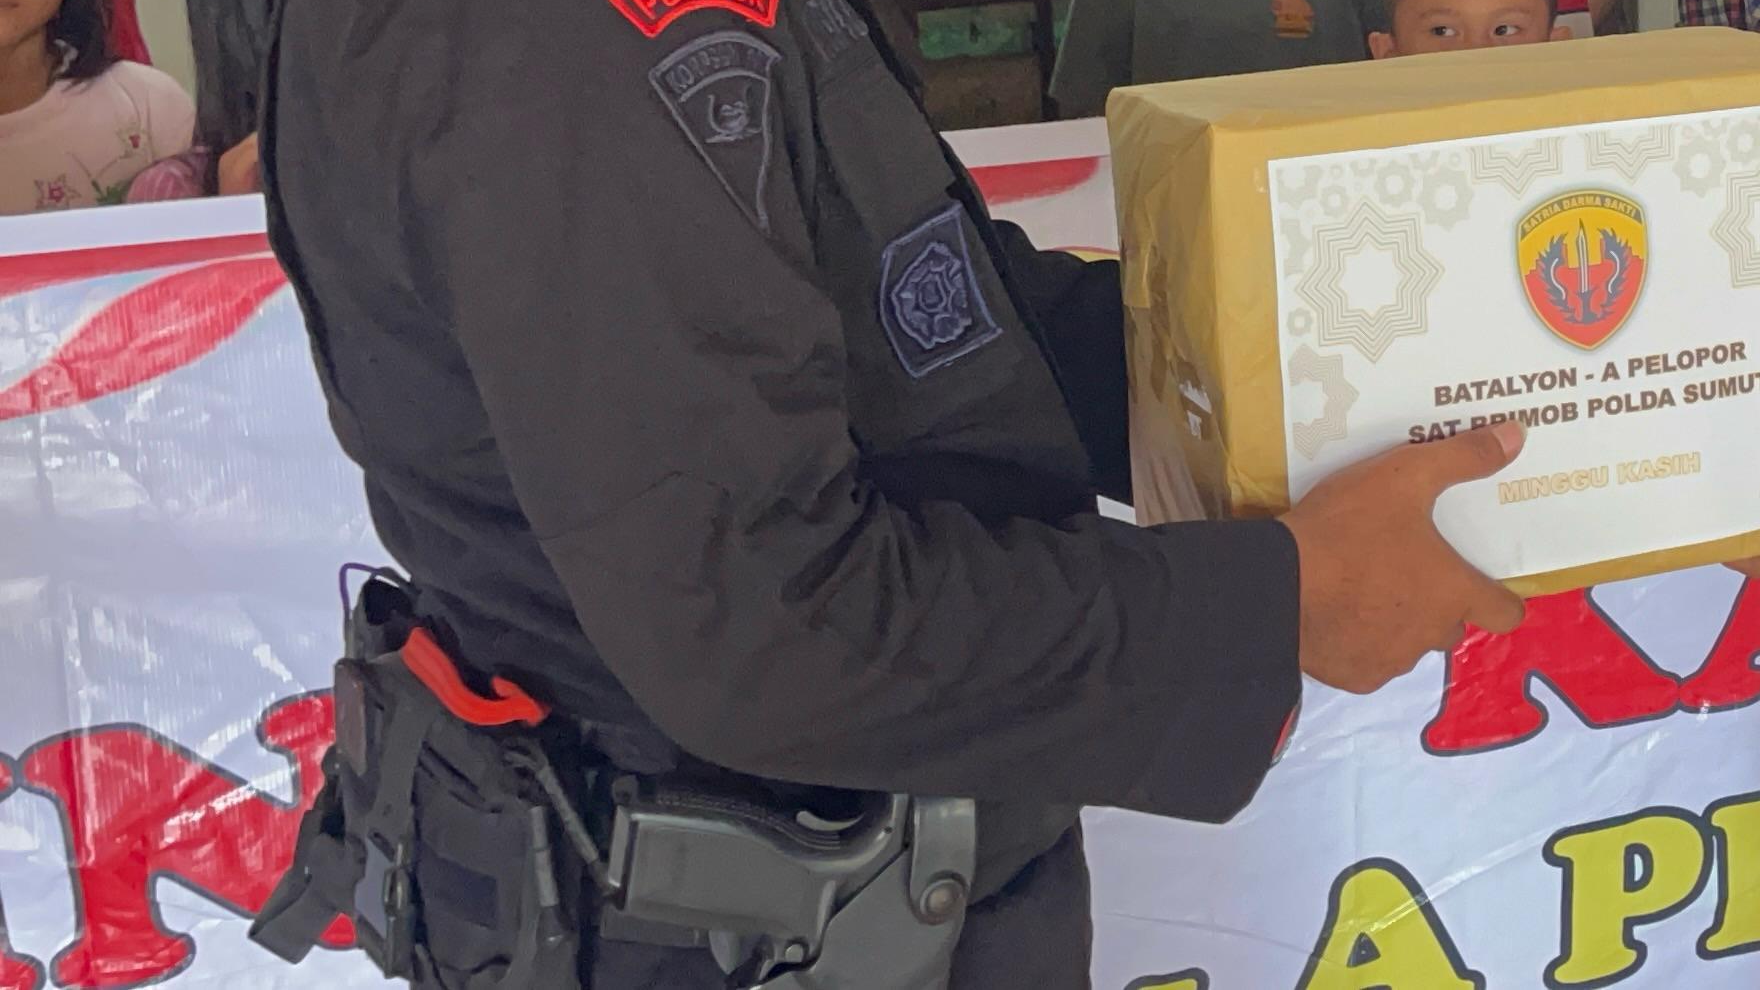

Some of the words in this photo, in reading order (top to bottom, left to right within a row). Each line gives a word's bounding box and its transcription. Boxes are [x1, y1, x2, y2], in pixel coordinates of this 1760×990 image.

[1522, 203, 1561, 231] SATRIA
[1603, 197, 1637, 217] SAKTI
[1434, 367, 1577, 407] BATALYON
[1601, 362, 1620, 382] A
[1628, 341, 1747, 378] PELOPOR
[1408, 419, 1462, 445] SAT
[1587, 388, 1676, 419] POLDA
[1498, 466, 1609, 504] MINGGU
[1616, 451, 1702, 485] KASIH
[1293, 856, 1486, 990] A
